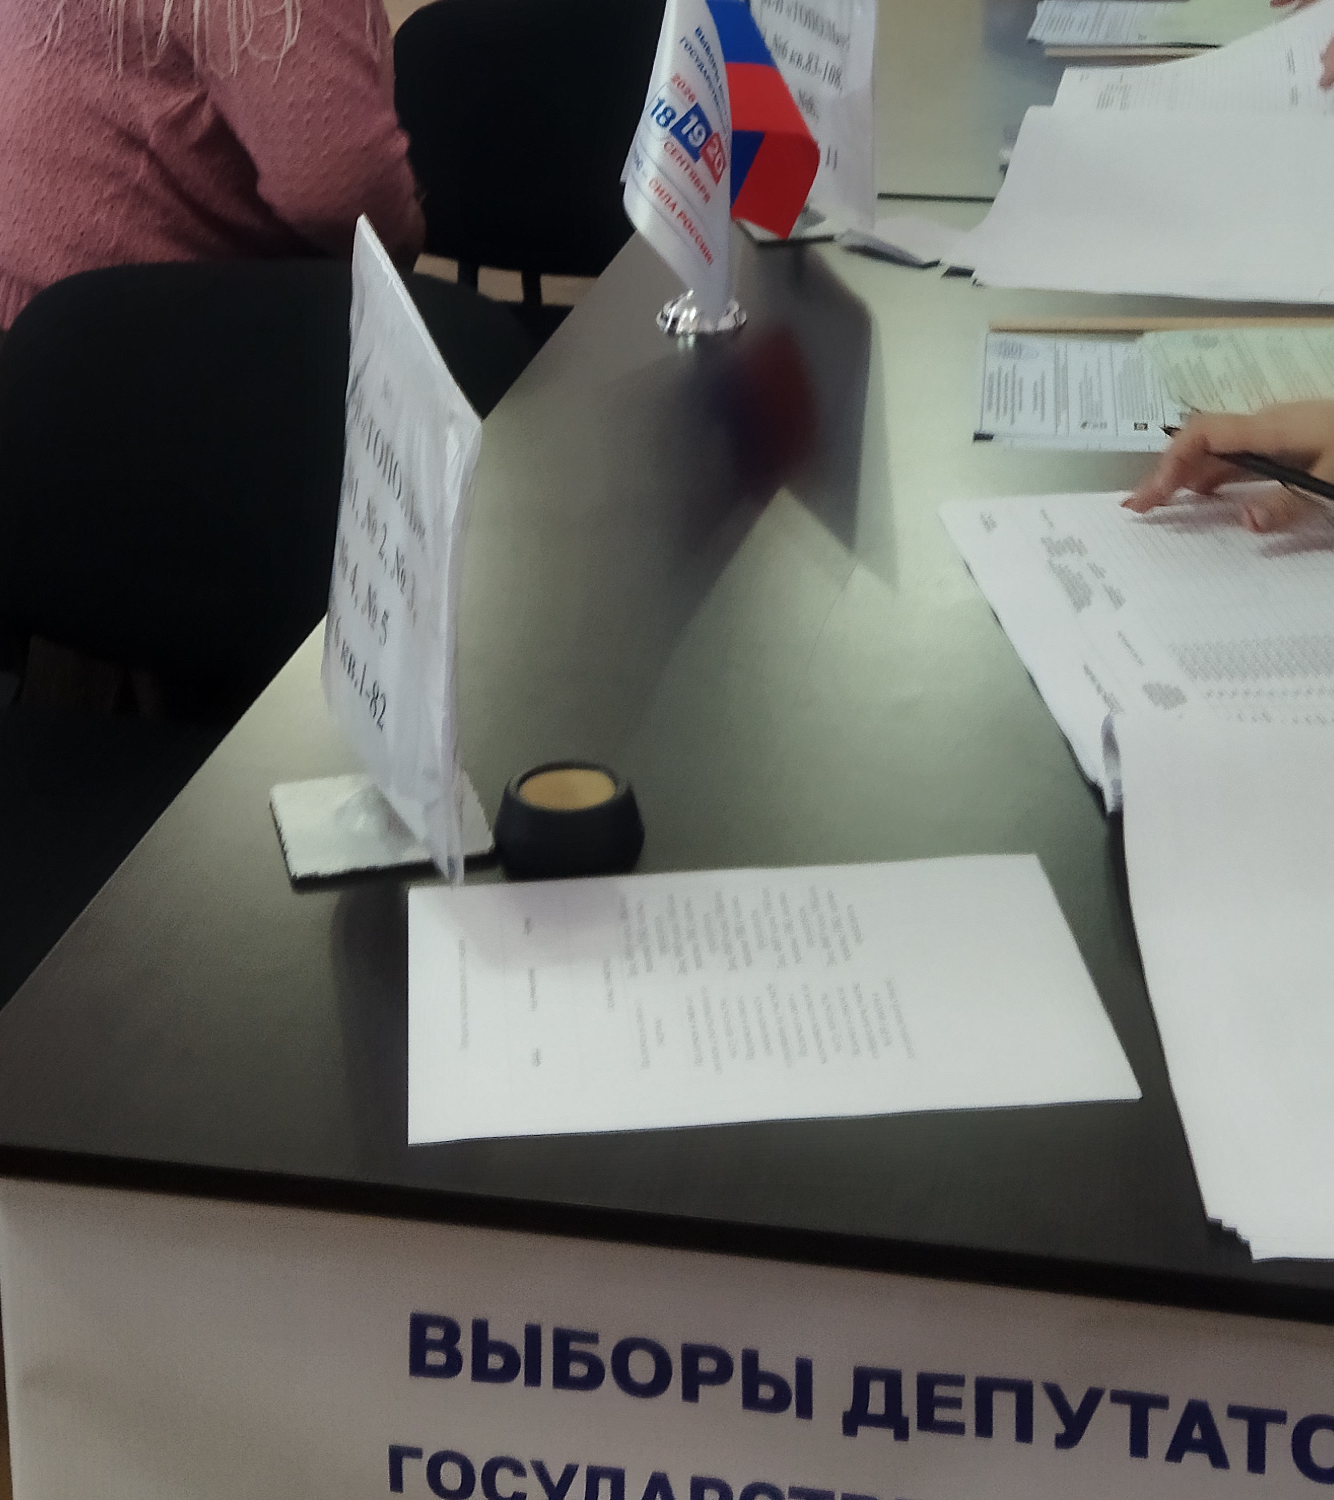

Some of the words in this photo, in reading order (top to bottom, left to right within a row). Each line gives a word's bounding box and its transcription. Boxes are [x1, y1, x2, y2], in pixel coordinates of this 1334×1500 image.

[650, 97, 677, 128] 18
[681, 114, 707, 148] 19
[705, 137, 725, 173] 20
[663, 141, 711, 203] СЕНТЯБРЯ
[648, 177, 677, 212] СИЛА
[677, 210, 714, 265] РОССИИ
[408, 1311, 814, 1421] ВЫБОРЫ
[387, 1443, 881, 1500] ГОСУДАР
